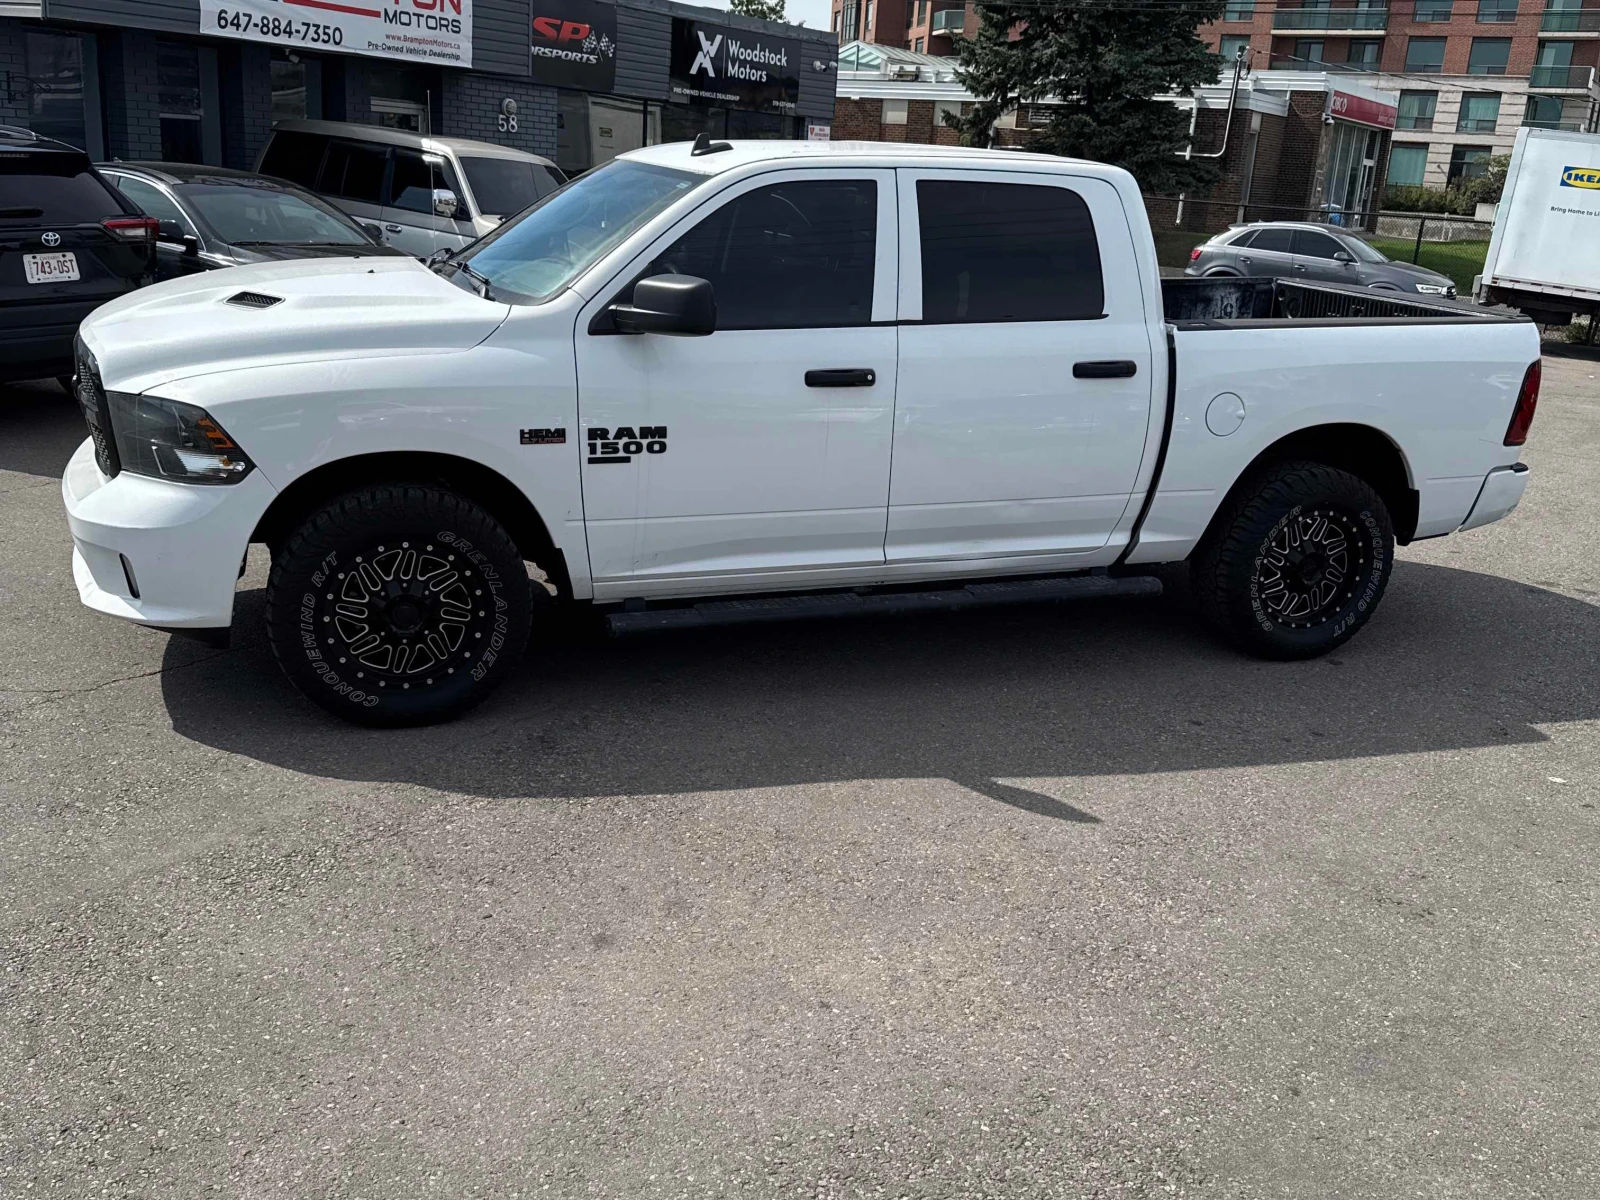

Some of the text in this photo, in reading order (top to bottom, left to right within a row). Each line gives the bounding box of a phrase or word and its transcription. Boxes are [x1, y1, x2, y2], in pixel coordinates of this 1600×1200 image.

[217, 9, 343, 46] 647-884-7350
[384, 8, 461, 34] MOTORS
[367, 41, 460, 61] Pre-Owned Vehicle Dealership
[385, 34, 460, 49] www.BramptonMotors.ca
[728, 39, 787, 67] Woodstock
[727, 60, 767, 82] Motors
[498, 114, 518, 133] 58
[1551, 206, 1567, 214] Bring
[32, 260, 53, 275] 743
[587, 426, 668, 441] RAM
[587, 440, 668, 455] 1500
[1358, 510, 1383, 612] CONQUEWIND
[436, 531, 508, 681] GRENLANDER
[300, 550, 379, 707] CONQUEWIND R/T
